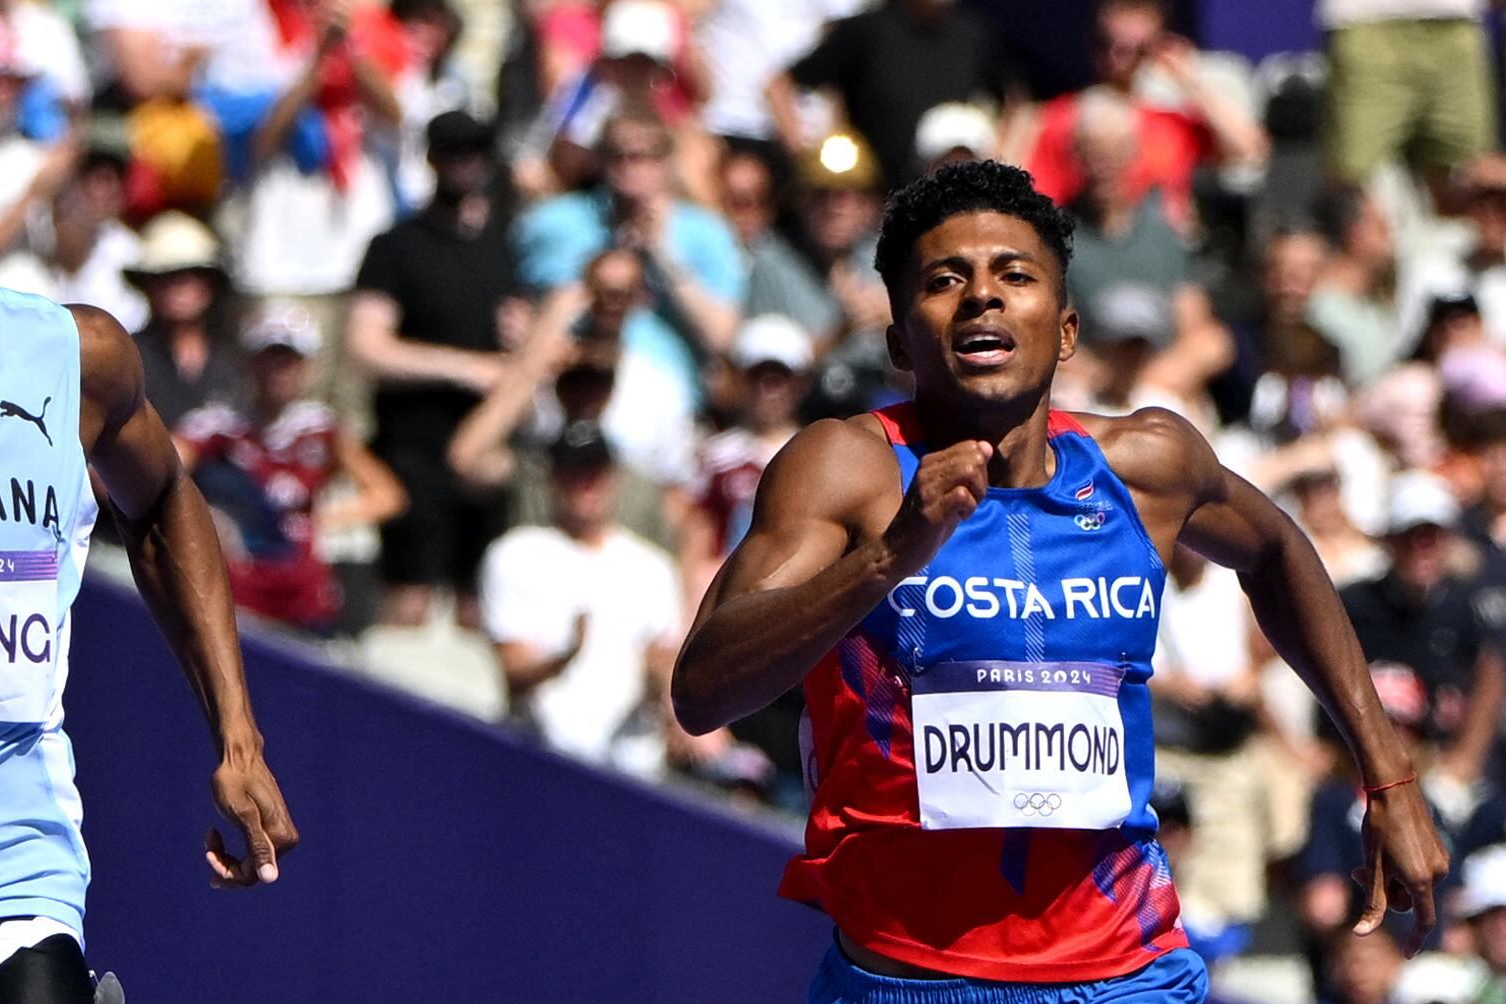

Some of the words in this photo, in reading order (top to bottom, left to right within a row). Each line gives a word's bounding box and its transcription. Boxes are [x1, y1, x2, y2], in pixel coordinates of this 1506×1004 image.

[887, 576, 1055, 619] COSTA
[1060, 576, 1155, 619] RICA
[977, 669, 1034, 683] PARIS
[1041, 671, 1092, 685] 2024
[923, 722, 1120, 776] DRUMMOND
